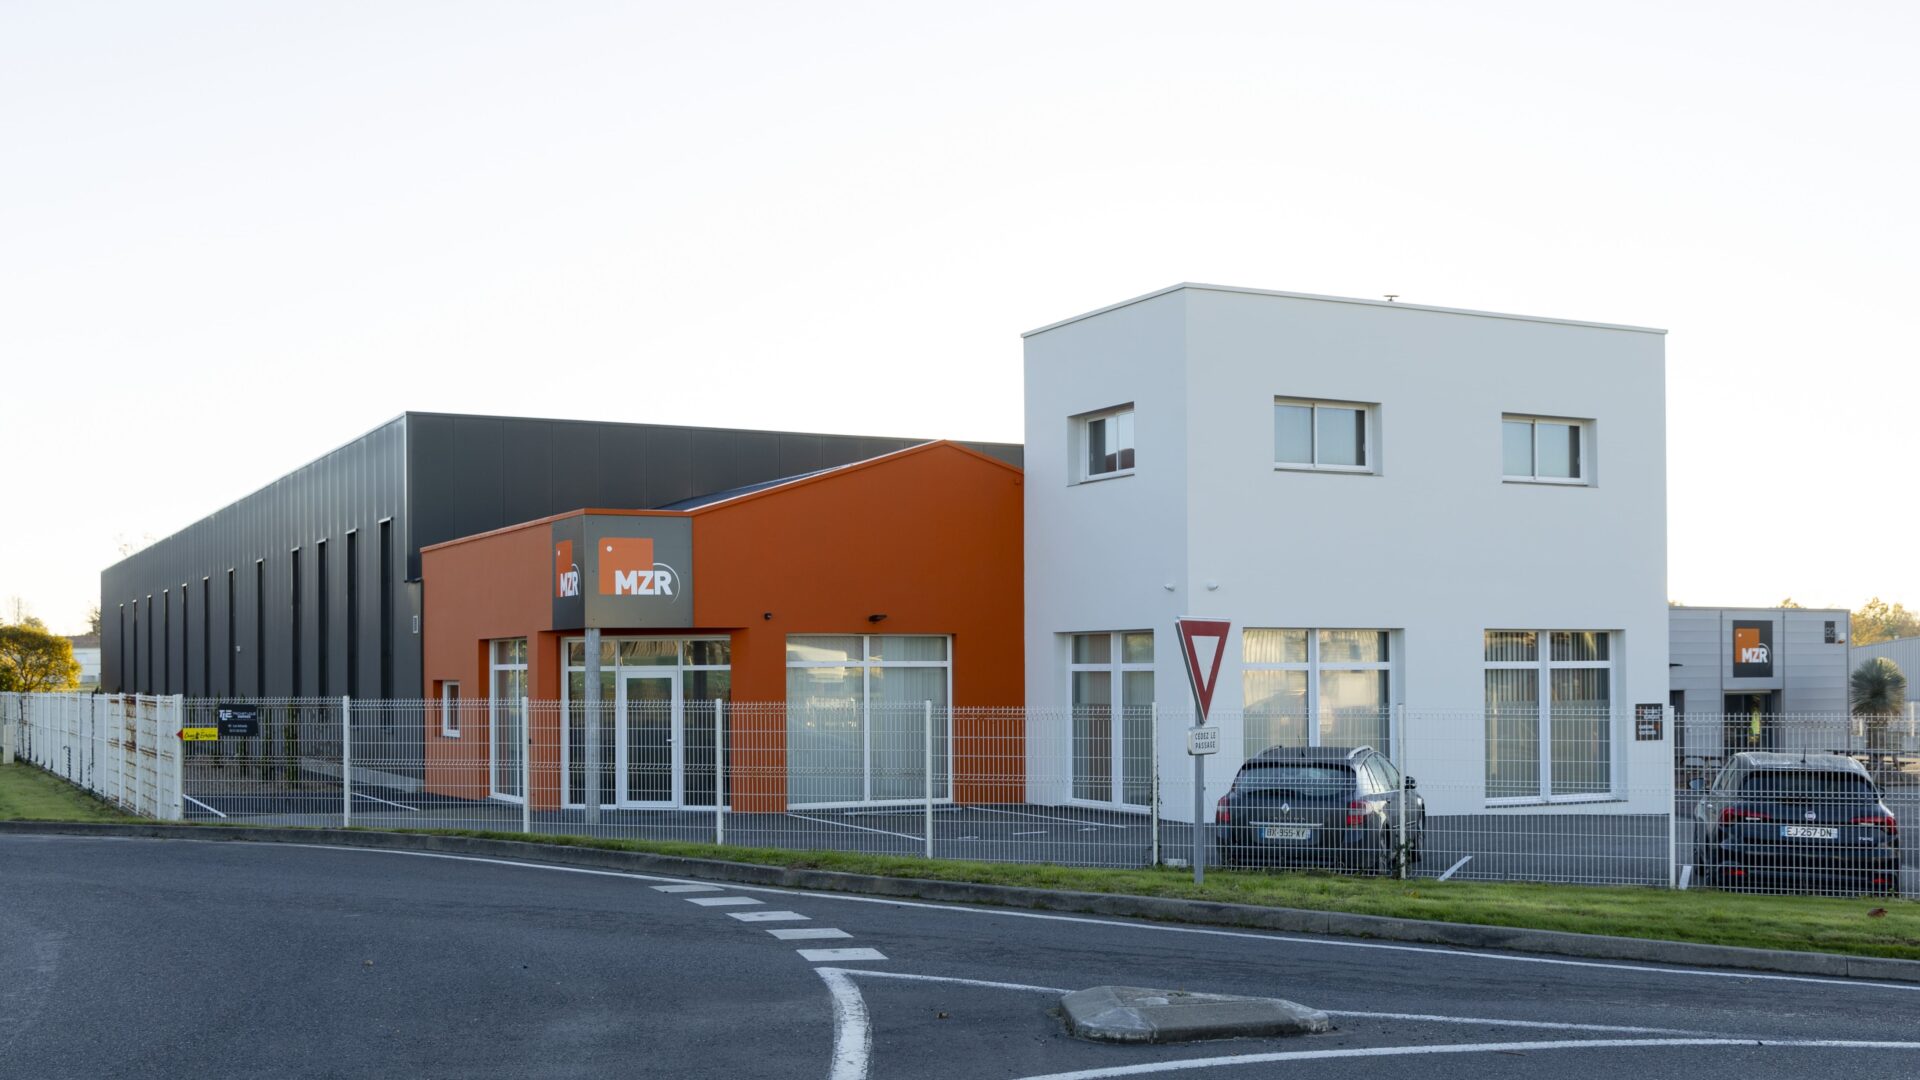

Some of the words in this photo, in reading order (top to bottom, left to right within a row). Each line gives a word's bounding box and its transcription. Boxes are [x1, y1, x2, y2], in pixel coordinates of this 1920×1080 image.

[560, 571, 578, 597] MZR
[615, 570, 672, 595] MZR
[1742, 648, 1768, 663] MZR
[1210, 731, 1216, 739] LE
[1195, 741, 1215, 749] PASSAGE
